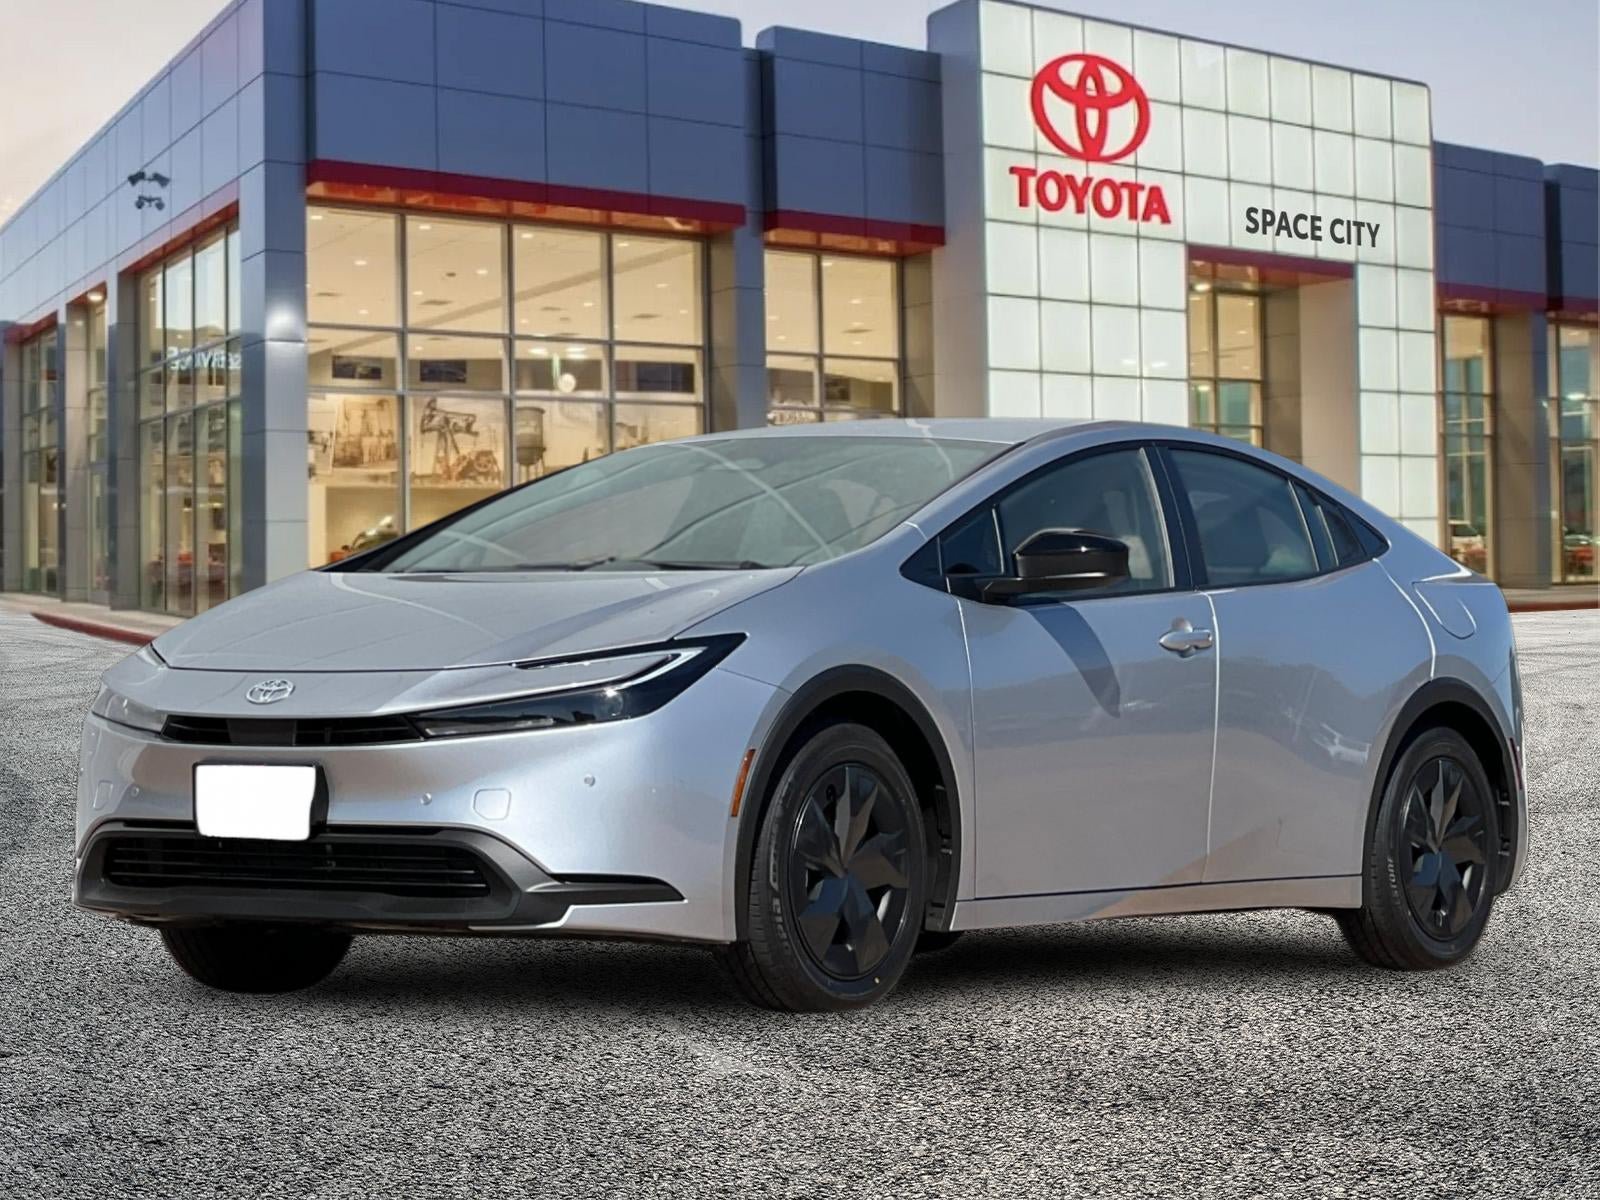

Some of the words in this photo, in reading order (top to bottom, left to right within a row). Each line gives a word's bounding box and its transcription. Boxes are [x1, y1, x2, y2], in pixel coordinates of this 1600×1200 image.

[1009, 166, 1171, 224] TOYOTA
[1245, 206, 1323, 242] SPACE
[1329, 217, 1381, 248] CITY
